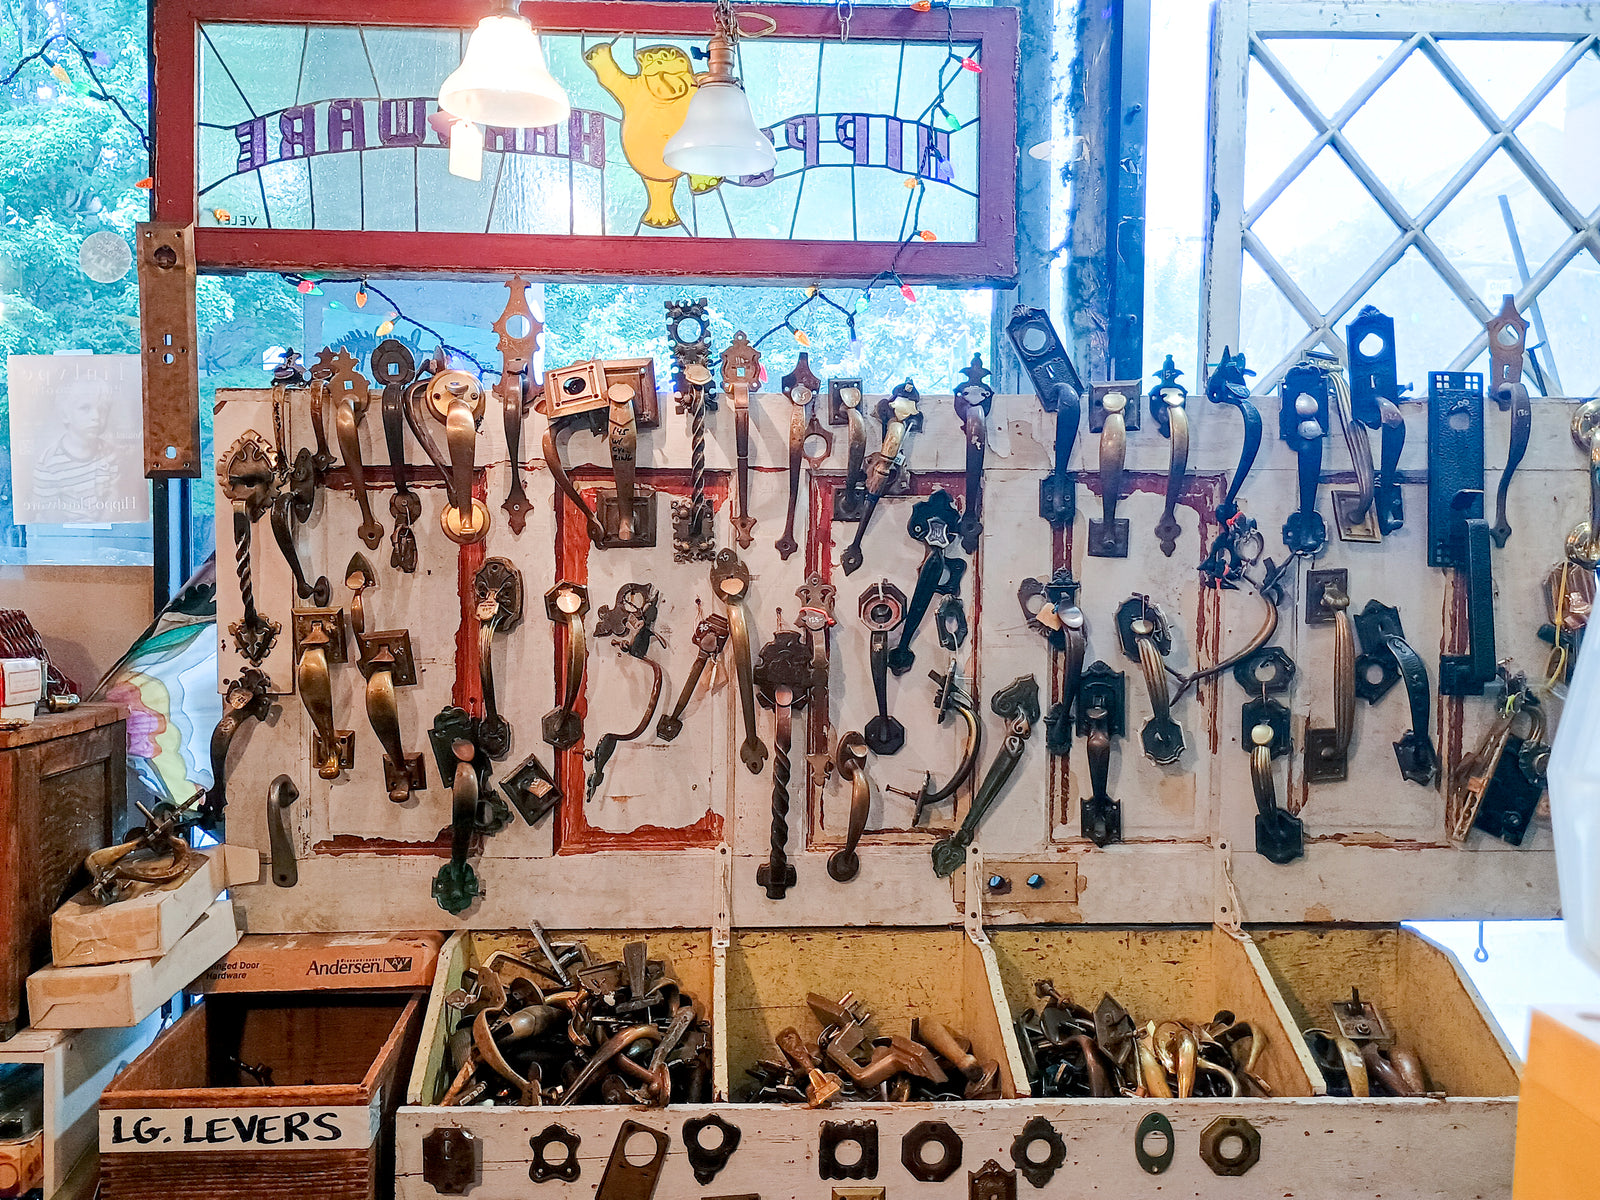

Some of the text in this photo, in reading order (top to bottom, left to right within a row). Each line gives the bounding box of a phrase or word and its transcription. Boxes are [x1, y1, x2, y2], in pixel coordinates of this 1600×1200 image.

[612, 426, 630, 436] 145
[209, 961, 260, 972] inged Door
[206, 971, 248, 980] Hardware
[111, 1111, 343, 1145] LG. LEVERS
